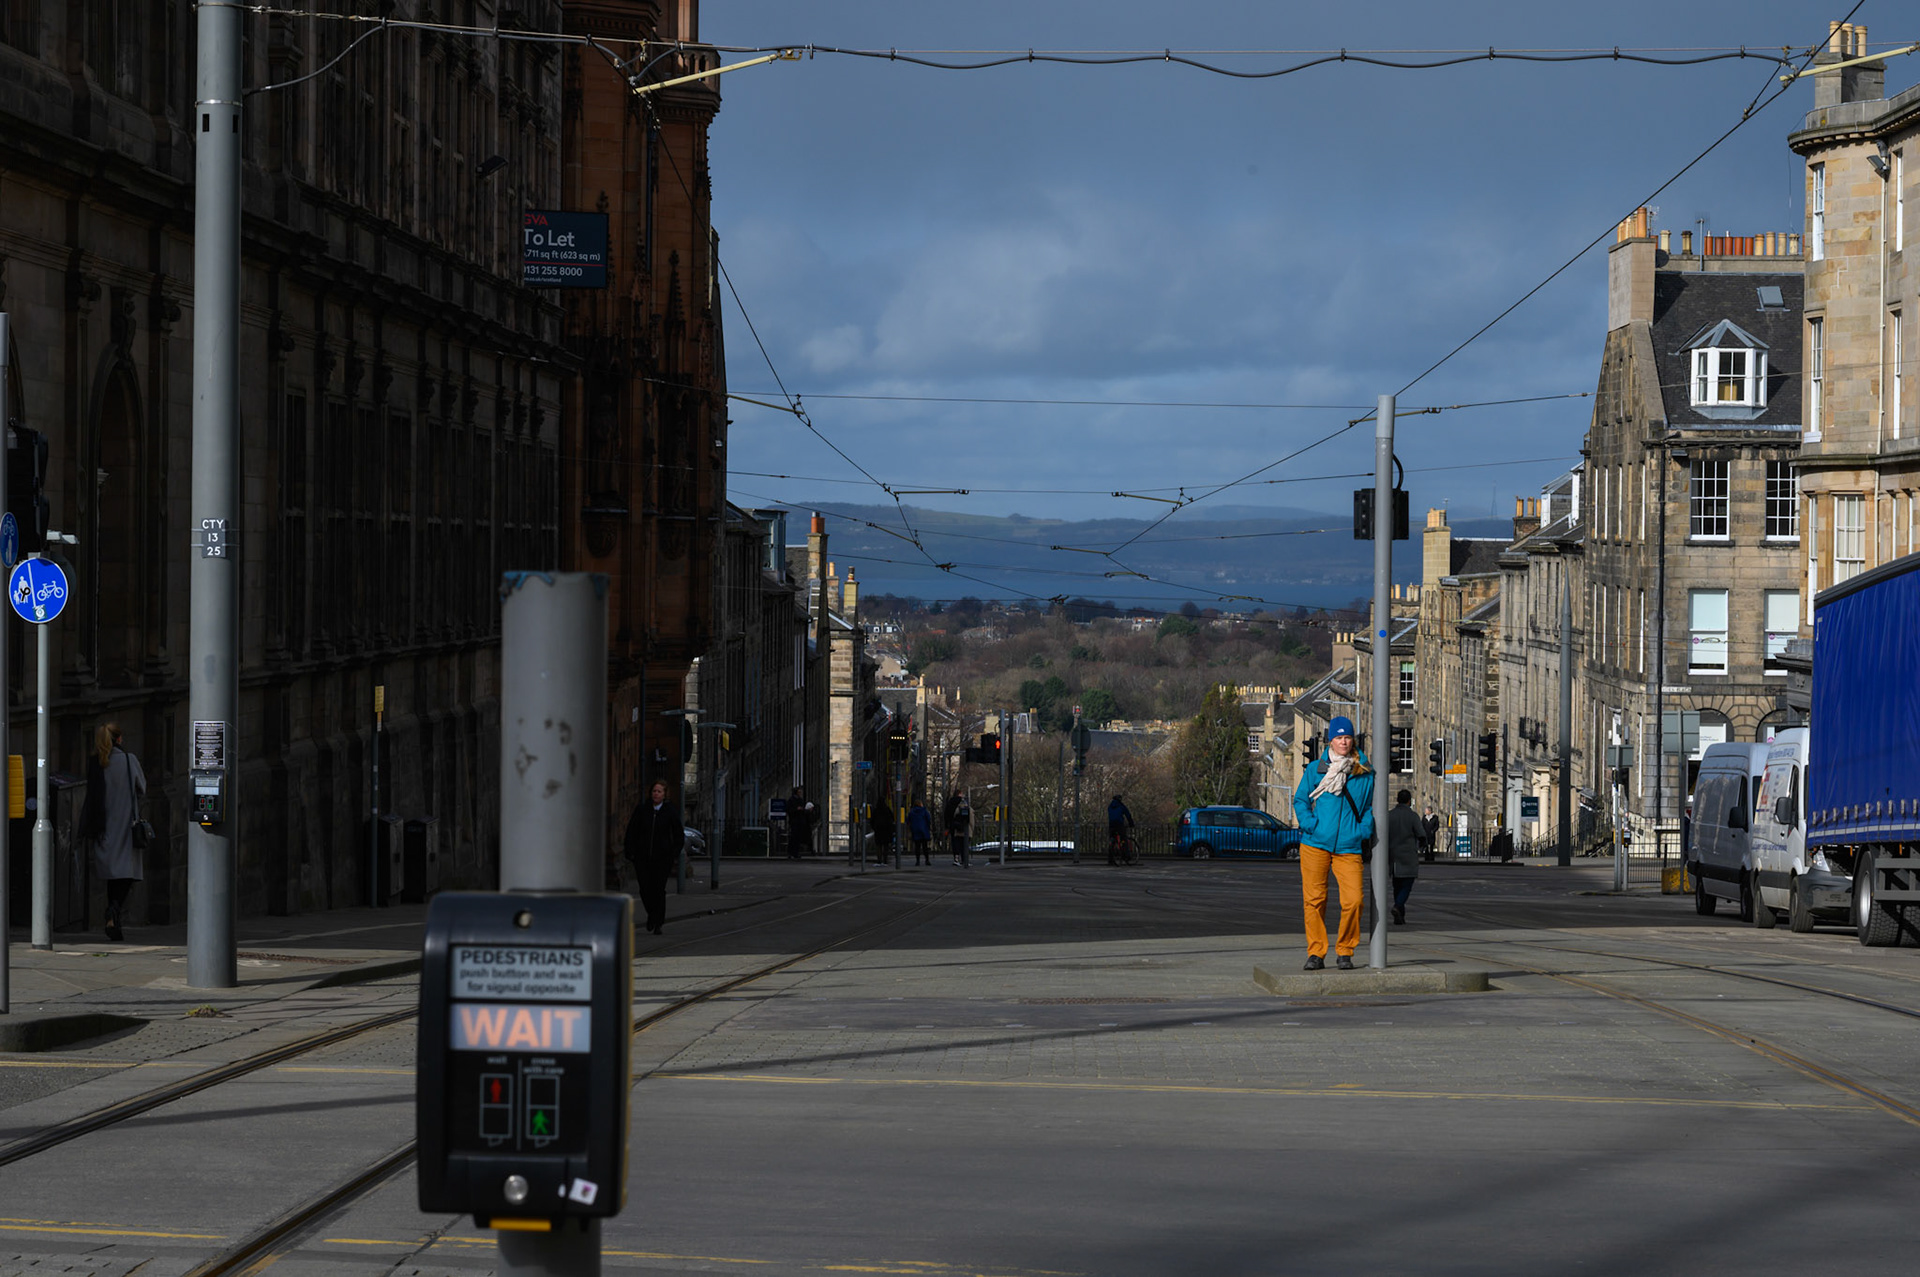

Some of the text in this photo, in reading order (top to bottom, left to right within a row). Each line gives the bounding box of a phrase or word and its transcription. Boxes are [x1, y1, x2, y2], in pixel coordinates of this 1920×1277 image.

[524, 228, 575, 247] To Let
[540, 251, 550, 260] sq
[551, 250, 559, 258] ft
[560, 250, 578, 260] (623
[579, 253, 588, 262] sq
[589, 253, 601, 262] m)
[541, 266, 558, 275] 255
[559, 267, 583, 277] 8000
[202, 519, 224, 529] CTY
[208, 533, 218, 542] 13
[207, 546, 221, 556] 25
[460, 950, 584, 966] PEDESTRIANS
[459, 968, 584, 981] push button and wait
[467, 981, 576, 995] for signal opposite
[460, 1008, 582, 1049] WAIT
